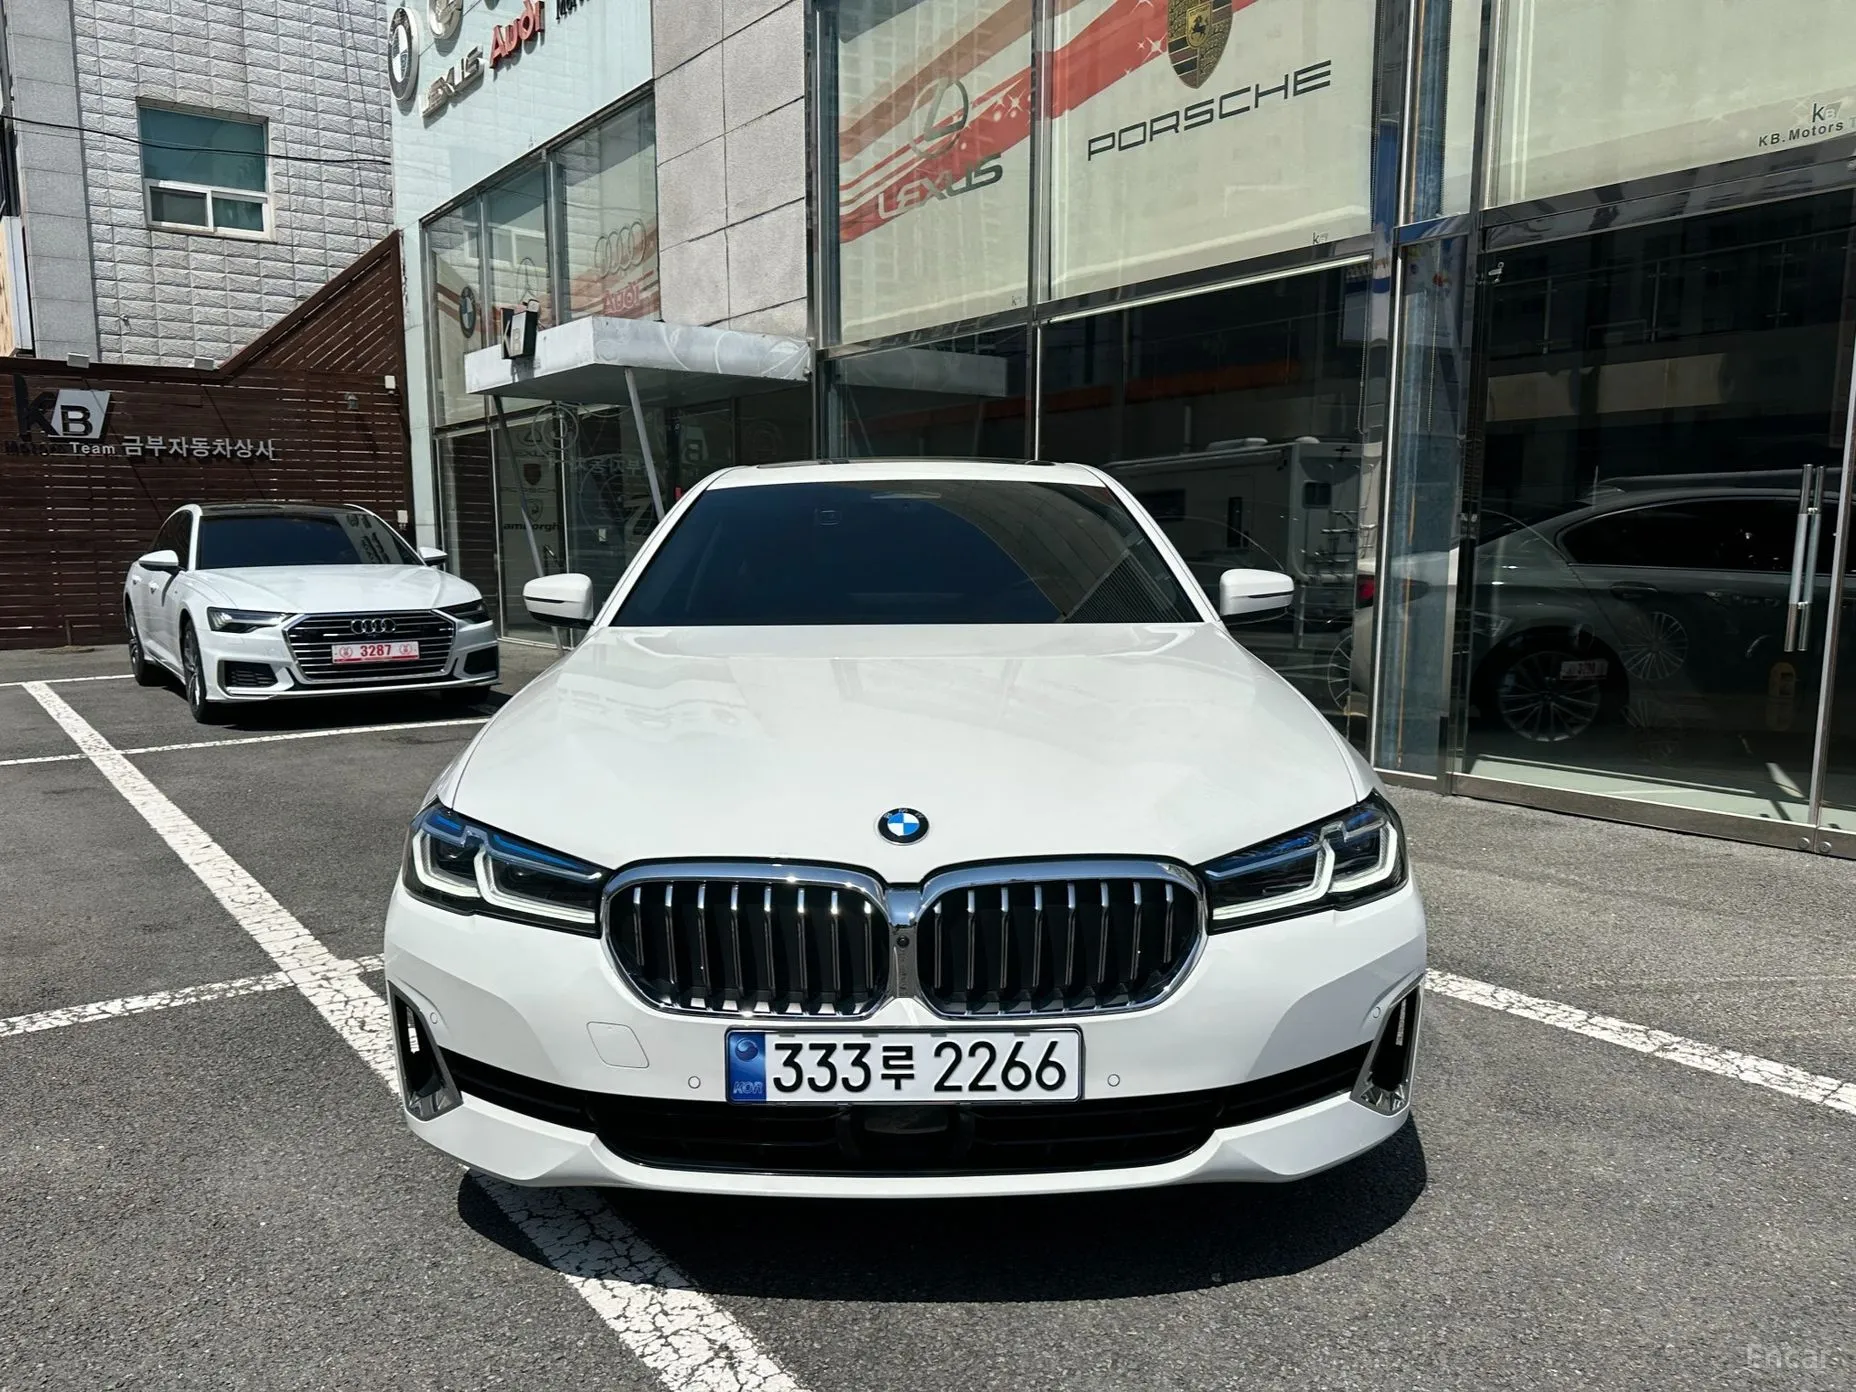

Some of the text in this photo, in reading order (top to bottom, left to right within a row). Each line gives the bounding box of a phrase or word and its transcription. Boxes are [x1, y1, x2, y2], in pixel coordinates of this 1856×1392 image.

[1086, 59, 1332, 162] PORSCHE
[876, 152, 1004, 220] LEXUS
[69, 442, 116, 455] Team
[121, 435, 276, 459] 금부자동차상사
[360, 644, 391, 657] 3287
[773, 1040, 1067, 1093] 333루 2266
